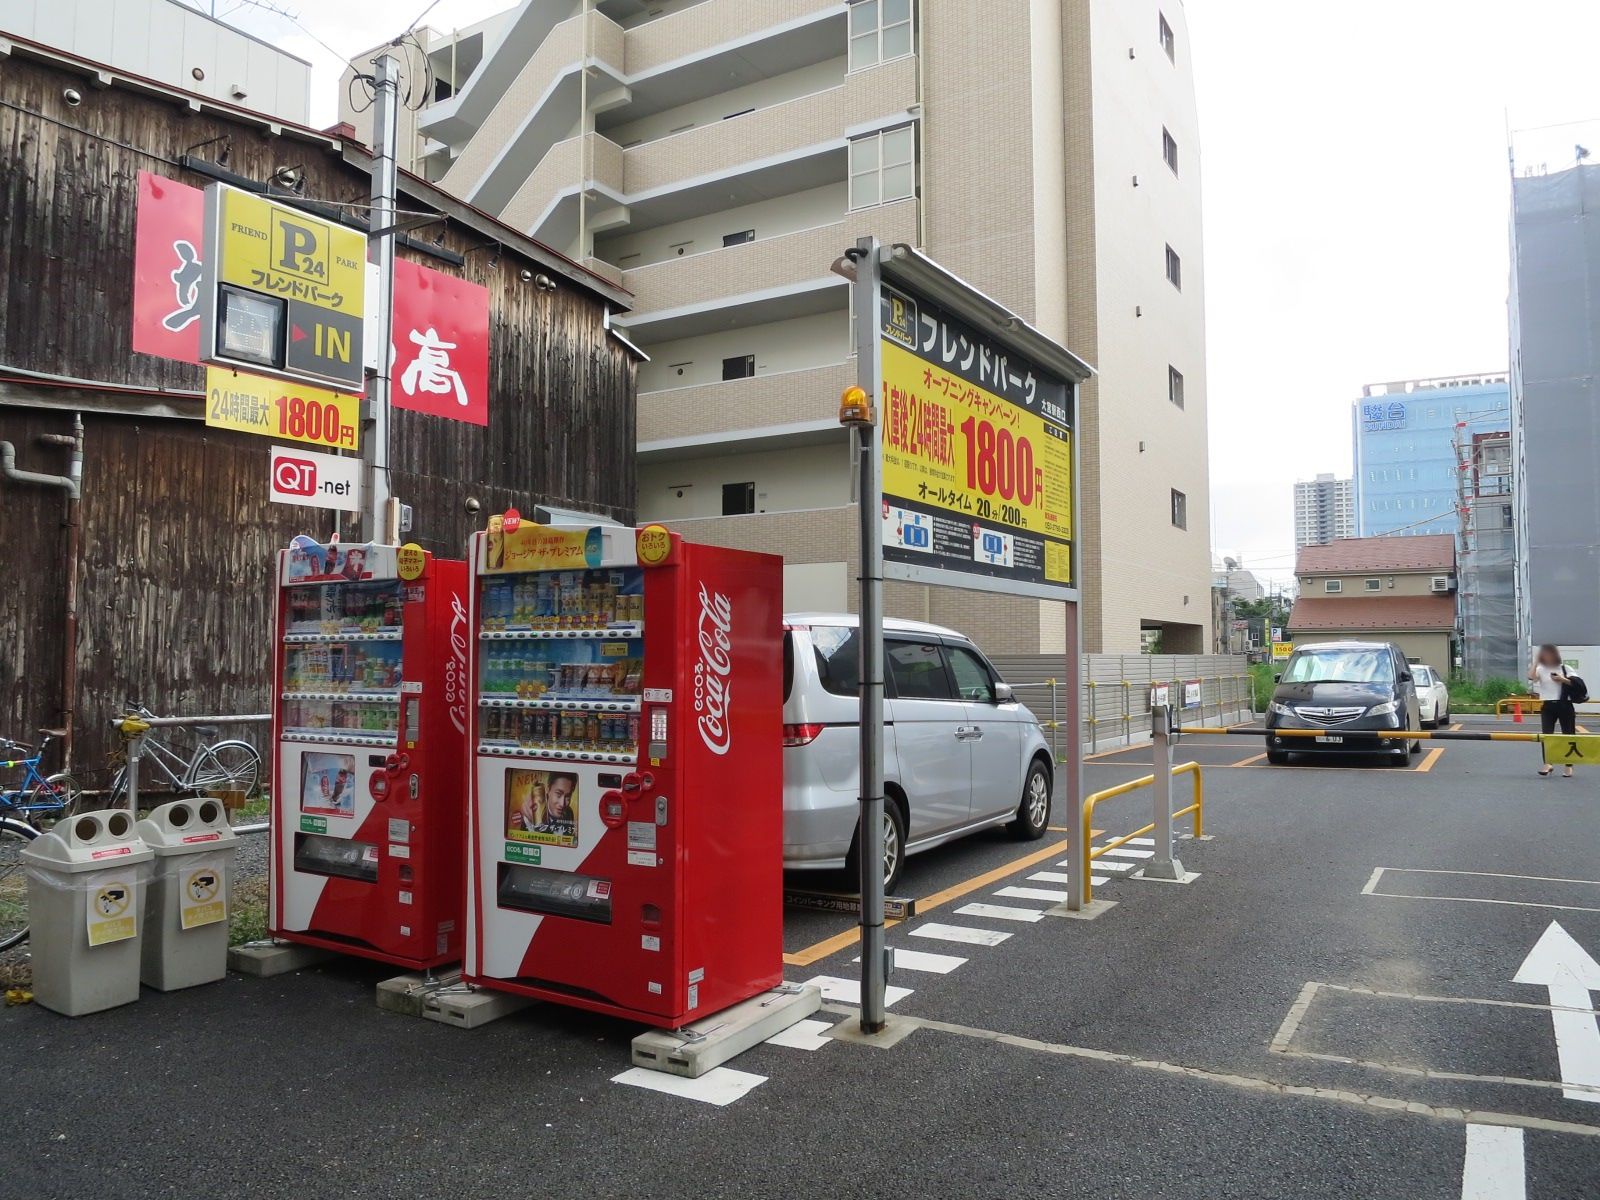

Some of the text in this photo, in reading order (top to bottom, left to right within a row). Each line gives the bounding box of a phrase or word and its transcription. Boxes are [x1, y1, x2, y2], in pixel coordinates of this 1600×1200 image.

[231, 222, 268, 241] FRIEND
[280, 221, 325, 278] P 24
[336, 255, 358, 270] PARK
[251, 269, 344, 308] フレンドパーク
[892, 298, 903, 324] P
[314, 323, 351, 363] IN
[401, 327, 468, 406] 高
[920, 313, 1037, 405] フレンドパーク
[211, 388, 355, 447] 24時間最大 1800円
[1363, 402, 1406, 420] 駿台
[275, 462, 351, 497] QT-net
[961, 420, 1043, 510] 1800円
[918, 481, 972, 510] オールタイム
[504, 516, 521, 526] NEW!
[642, 532, 666, 541] おトク
[642, 542, 666, 550] いろいろ
[505, 548, 536, 560] ジョージア
[698, 579, 732, 756] Coca-Cola
[1564, 741, 1584, 758] 入
